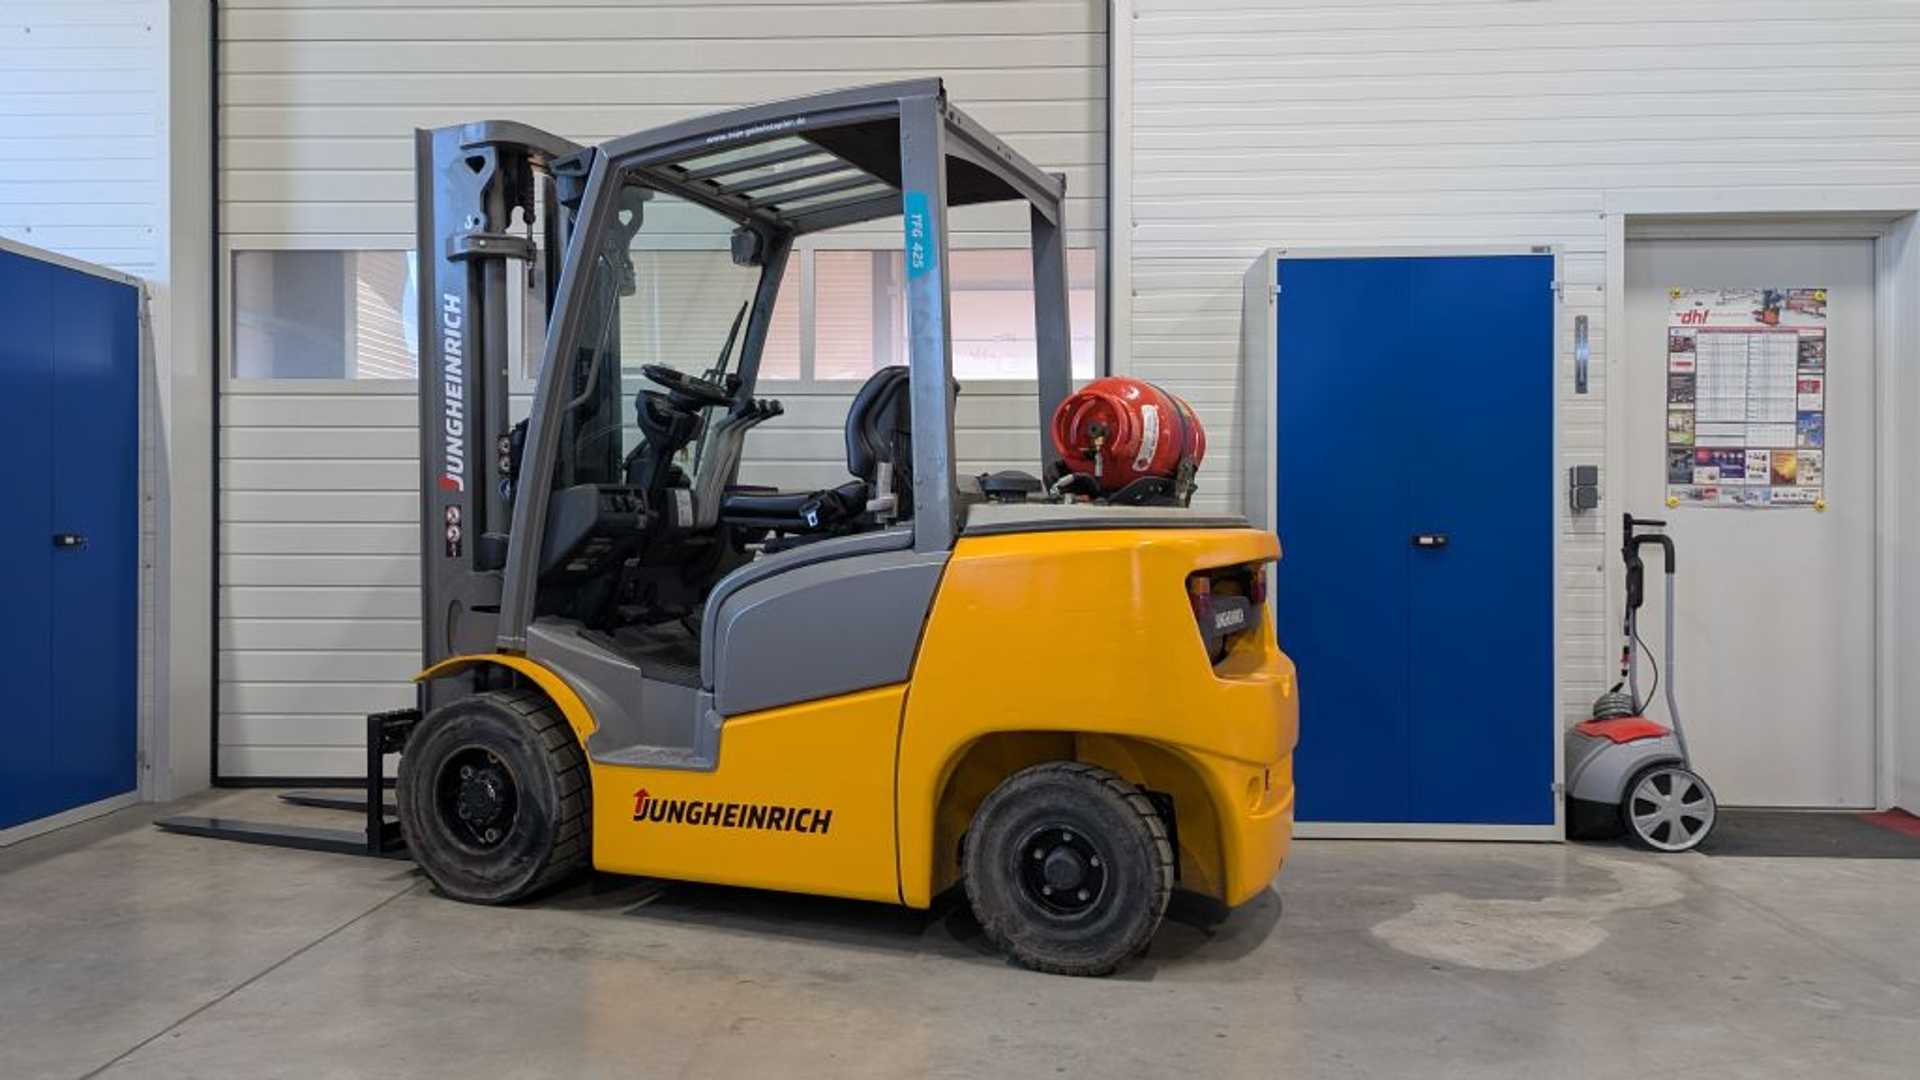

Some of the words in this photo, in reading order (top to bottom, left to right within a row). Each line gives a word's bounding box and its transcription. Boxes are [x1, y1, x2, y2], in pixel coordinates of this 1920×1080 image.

[911, 213, 923, 239] TFG
[911, 242, 925, 269] 425
[444, 293, 464, 492] JUNGHEINRICH
[633, 798, 833, 834] JUNGHEINRICH
